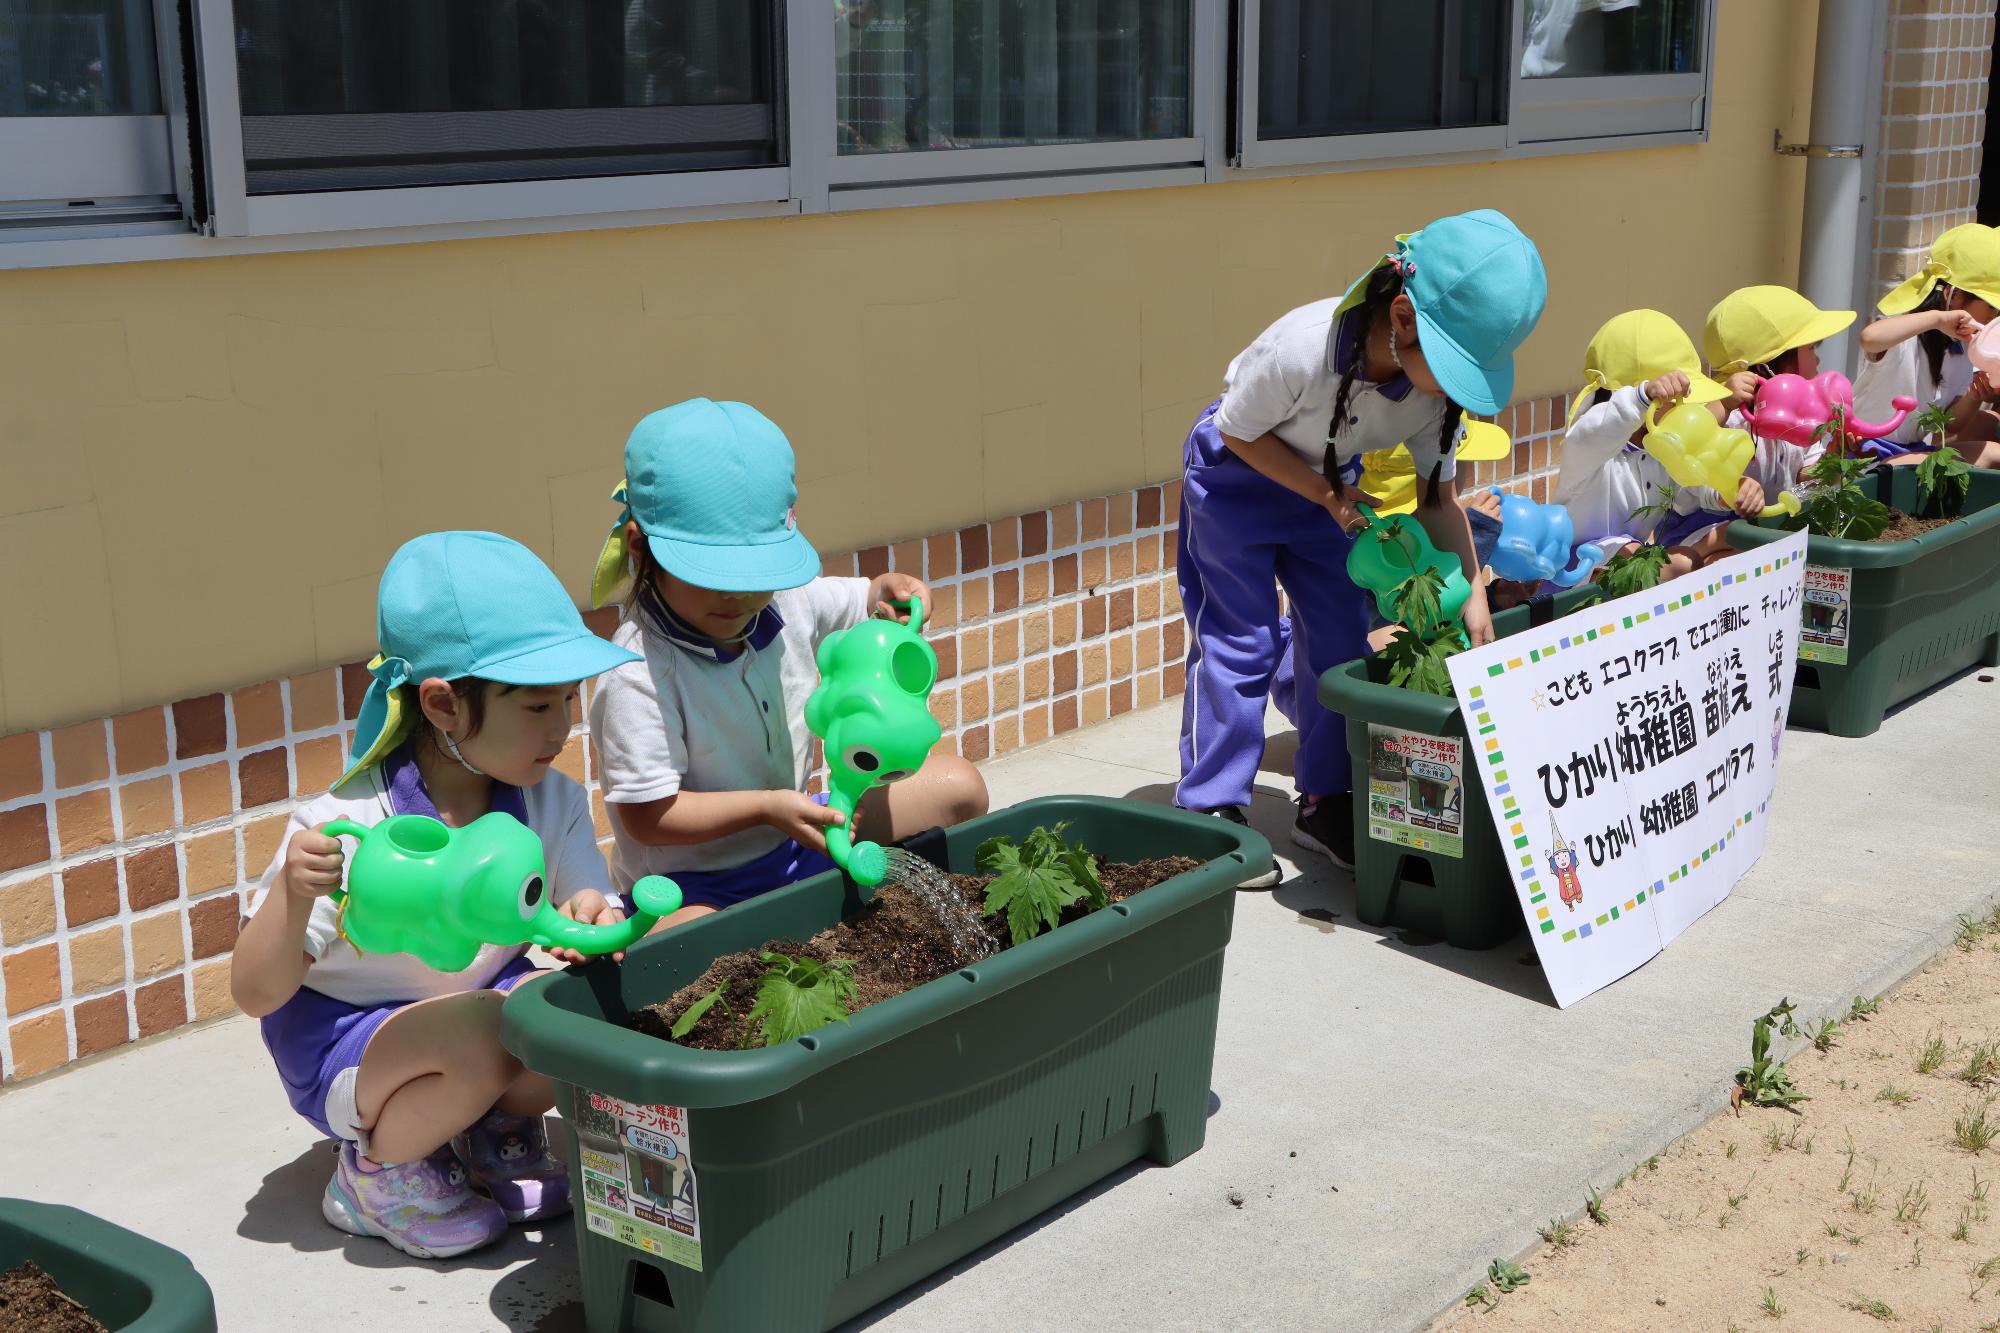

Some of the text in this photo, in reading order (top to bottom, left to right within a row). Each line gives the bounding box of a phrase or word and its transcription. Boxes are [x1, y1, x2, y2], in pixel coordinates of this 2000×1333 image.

[1768, 628, 1784, 655] しき
[1547, 670, 1593, 707] こども
[1600, 636, 1681, 686] エコクラブ
[1768, 650, 1783, 699] 式
[1616, 679, 1687, 726] ようちえん
[1401, 734, 1460, 754] 水やりを軽減!
[591, 1093, 687, 1138] 緑のカーテン作り。
